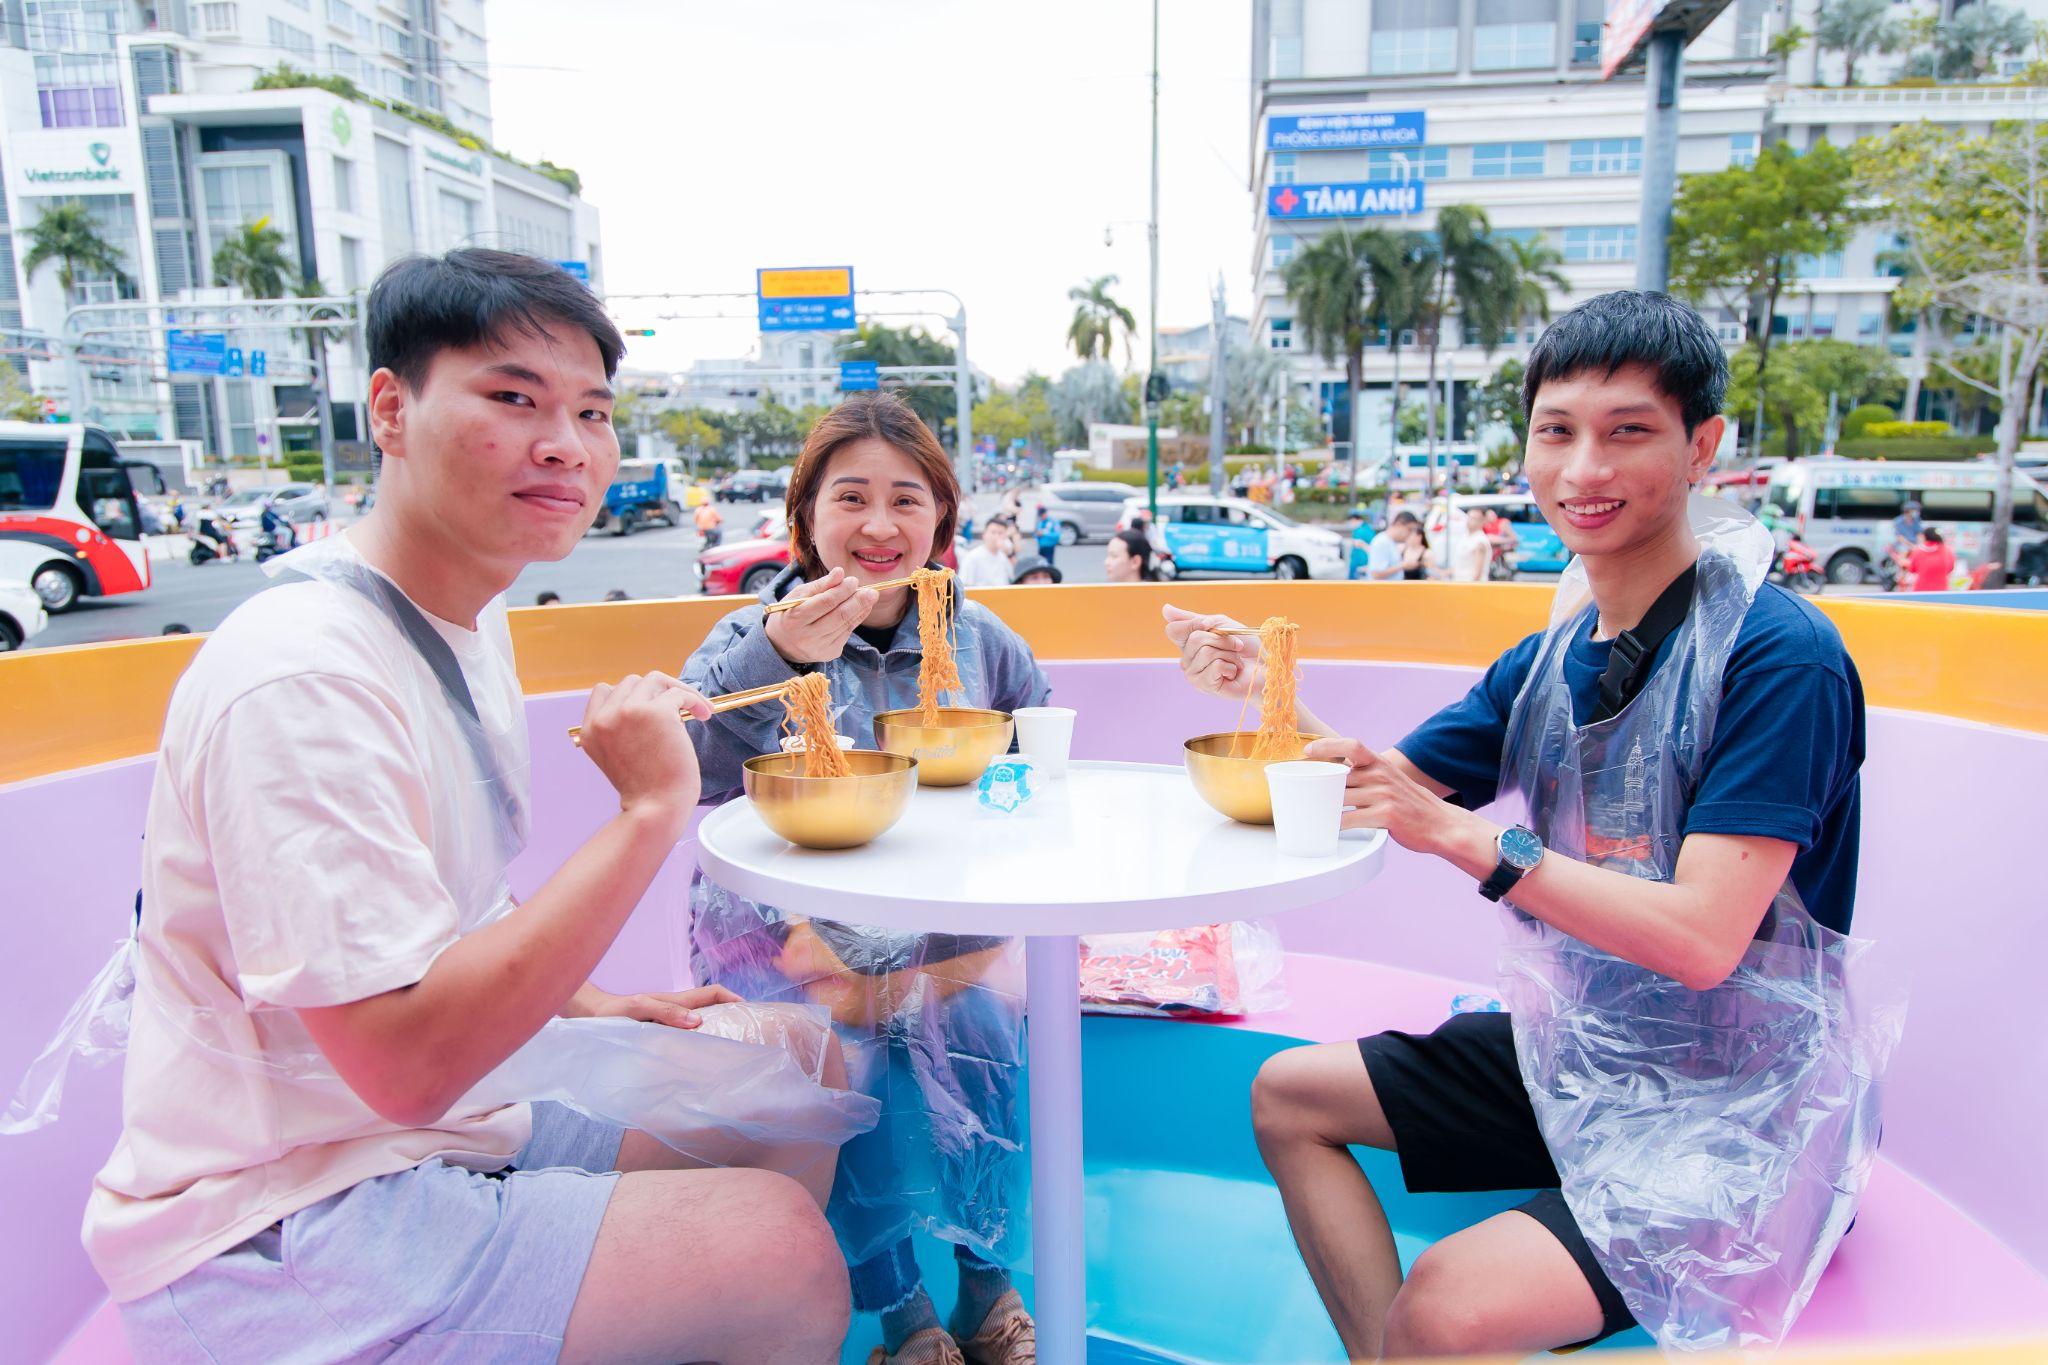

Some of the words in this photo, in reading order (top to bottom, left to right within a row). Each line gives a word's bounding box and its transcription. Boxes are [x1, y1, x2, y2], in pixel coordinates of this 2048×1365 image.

[1273, 130, 1320, 147] PHÒNG
[1381, 127, 1418, 144] KHOA
[23, 165, 121, 183] Vietcombank
[1303, 185, 1357, 214] TÂM
[1360, 187, 1416, 212] ANH
